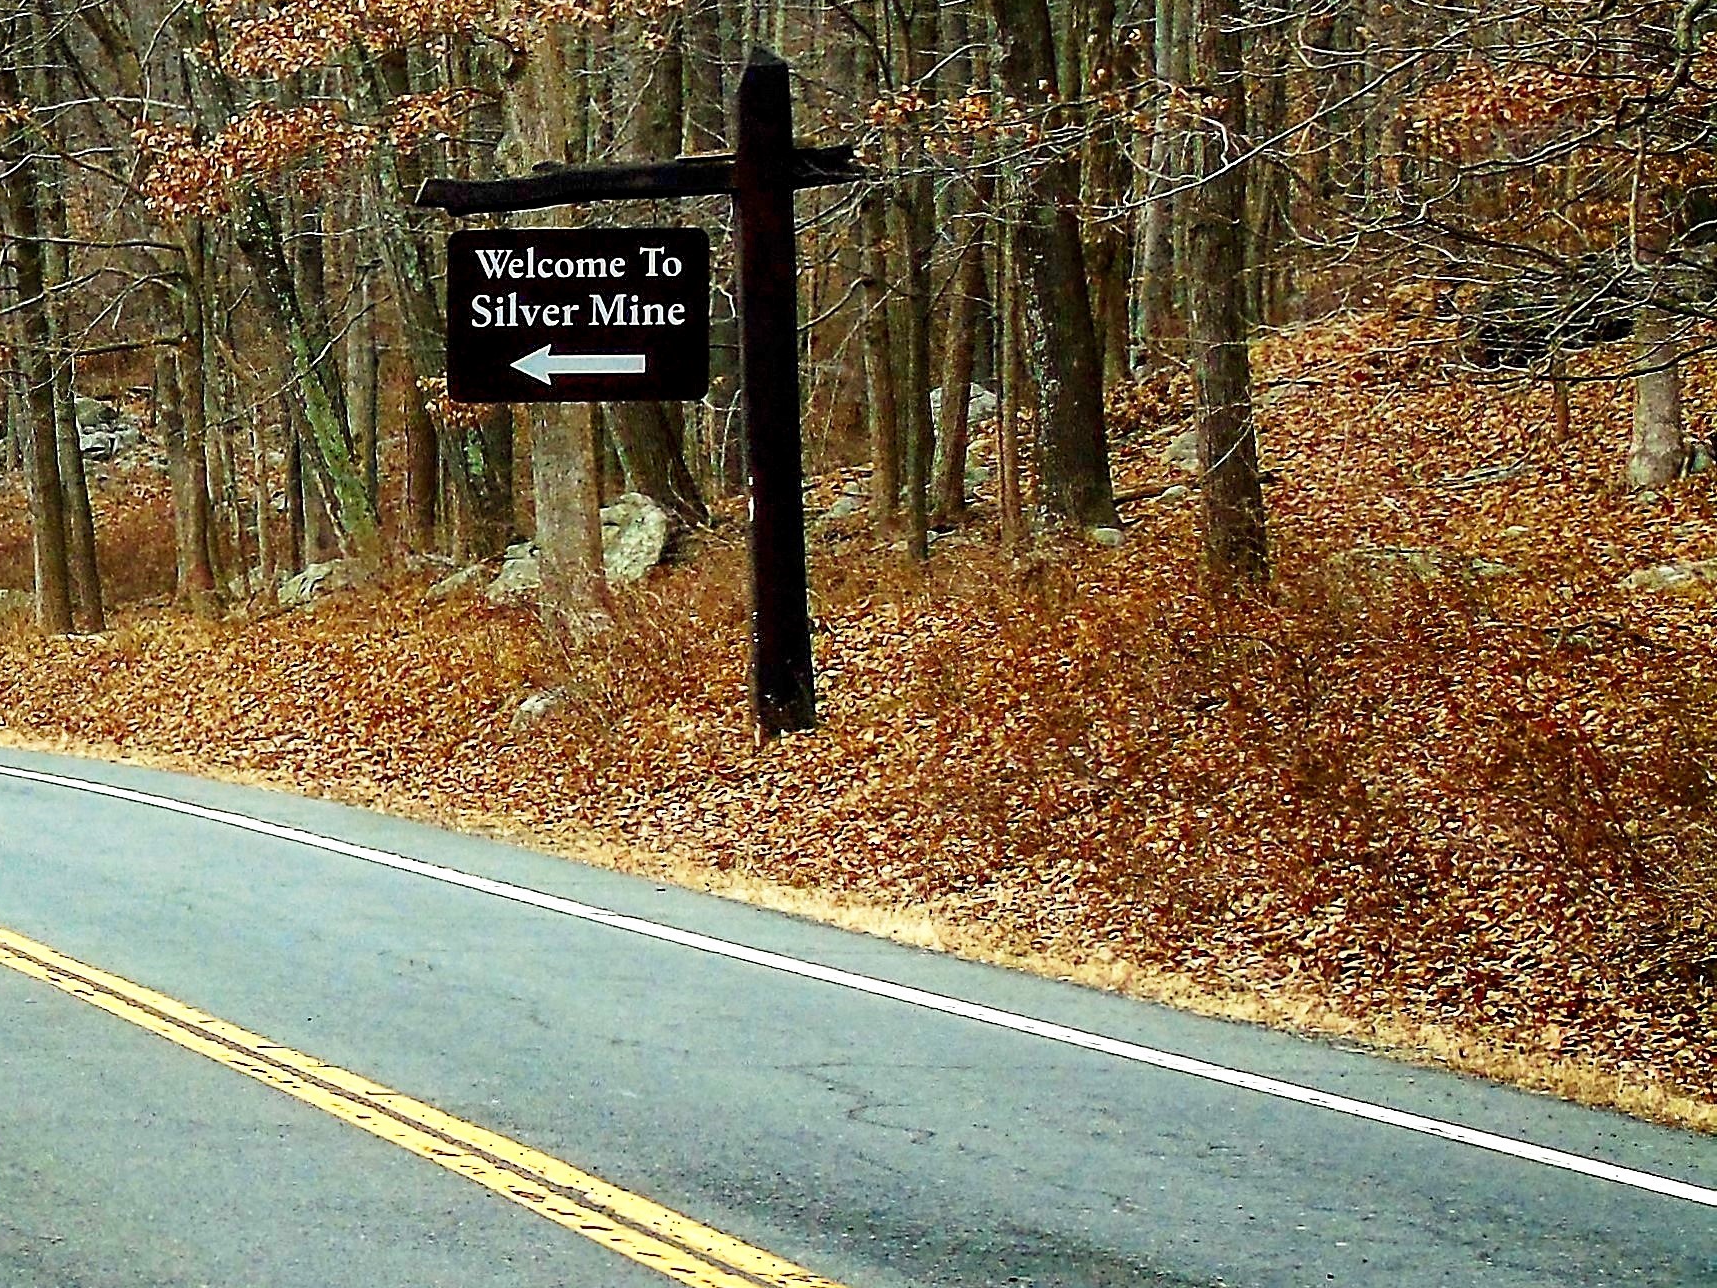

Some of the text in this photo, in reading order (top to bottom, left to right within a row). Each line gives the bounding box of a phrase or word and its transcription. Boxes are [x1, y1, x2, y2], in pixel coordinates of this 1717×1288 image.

[474, 247, 682, 279] Welcome To
[471, 292, 686, 327] Silver Mine
